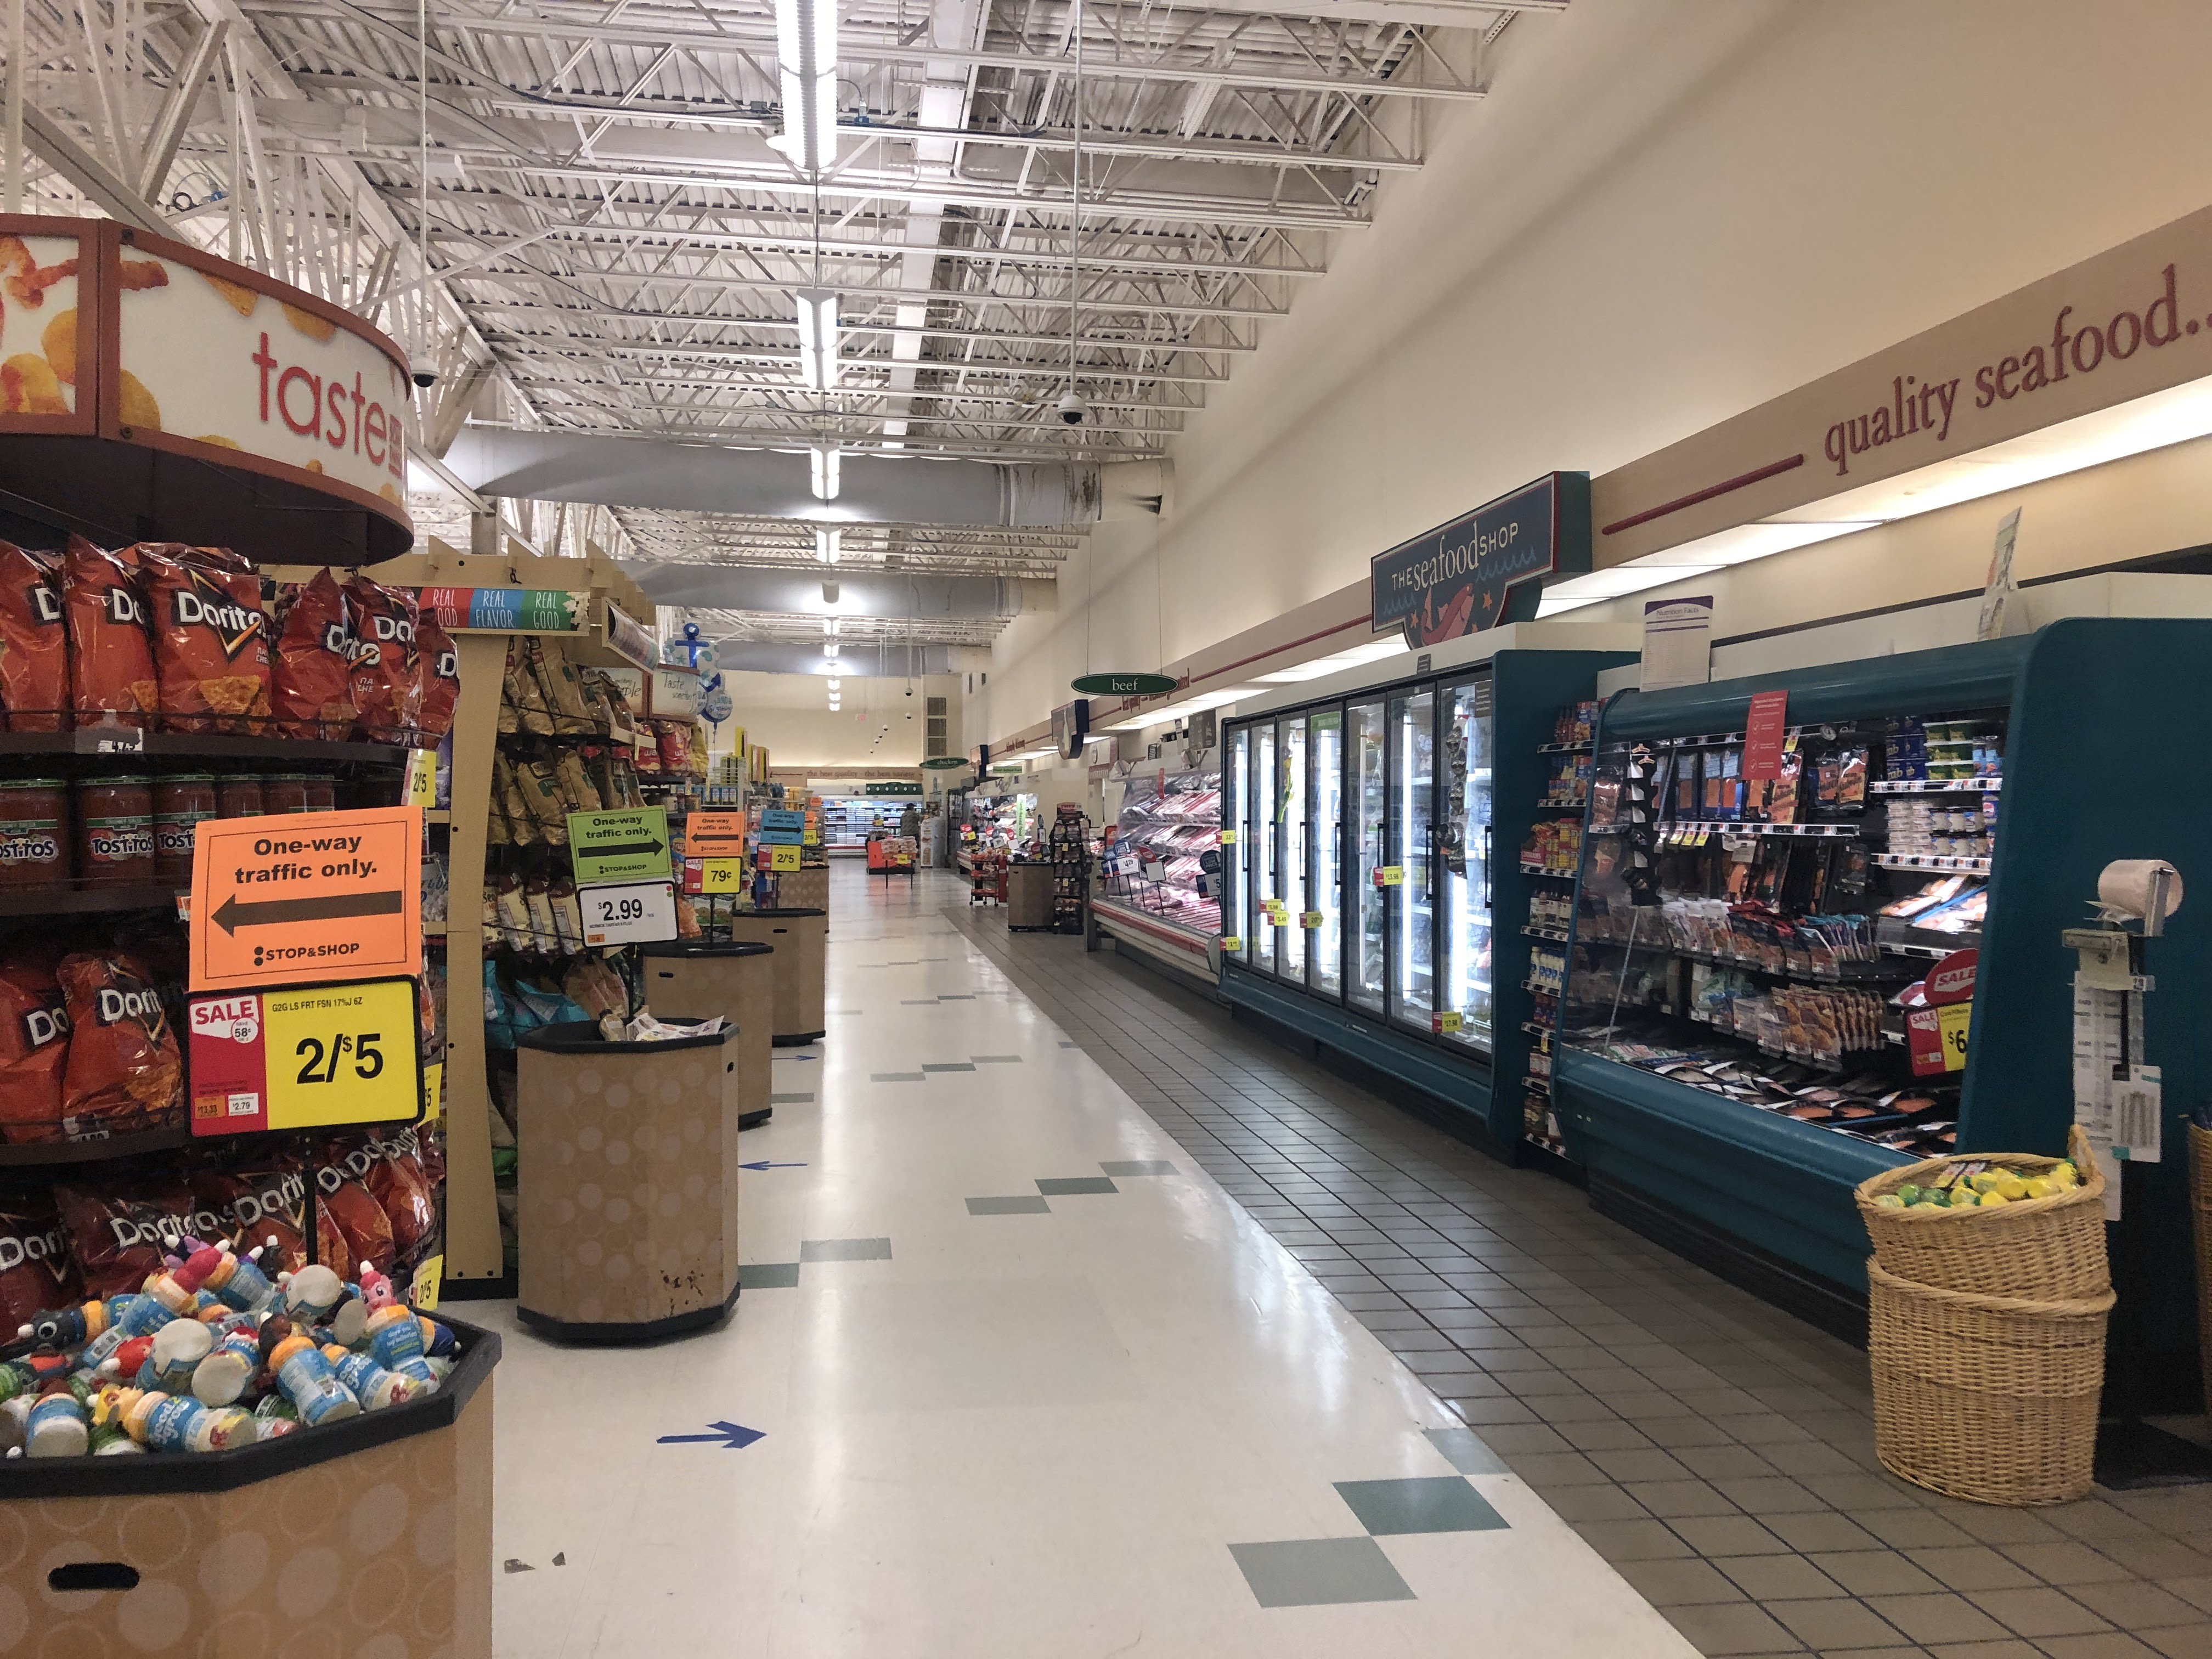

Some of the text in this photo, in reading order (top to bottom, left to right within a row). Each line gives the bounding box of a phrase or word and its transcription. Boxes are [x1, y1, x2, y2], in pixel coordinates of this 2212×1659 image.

[252, 331, 387, 466] taste
[1825, 375, 1960, 476] quality
[1391, 521, 1518, 591] THE seafood SHOP
[433, 589, 454, 606] REAL
[483, 590, 504, 607] REAL
[535, 591, 557, 607] REAL
[177, 591, 266, 637] Dorito
[437, 608, 458, 627] OOD
[661, 672, 685, 689] Taste
[1112, 678, 1138, 691] beef
[592, 816, 642, 826] One-way
[159, 831, 194, 848] TOST
[586, 827, 652, 839] traffic only.
[0, 840, 54, 858] STITOS
[254, 836, 362, 856] One-way
[235, 859, 377, 883] traffic only.
[598, 899, 642, 921] $2.99
[266, 943, 360, 961] STOP&SHOP
[195, 1000, 255, 1025] SALE
[1912, 1013, 1935, 1025] SALE
[296, 1033, 383, 1085] 2/$5
[233, 1101, 251, 1110] $2.79
